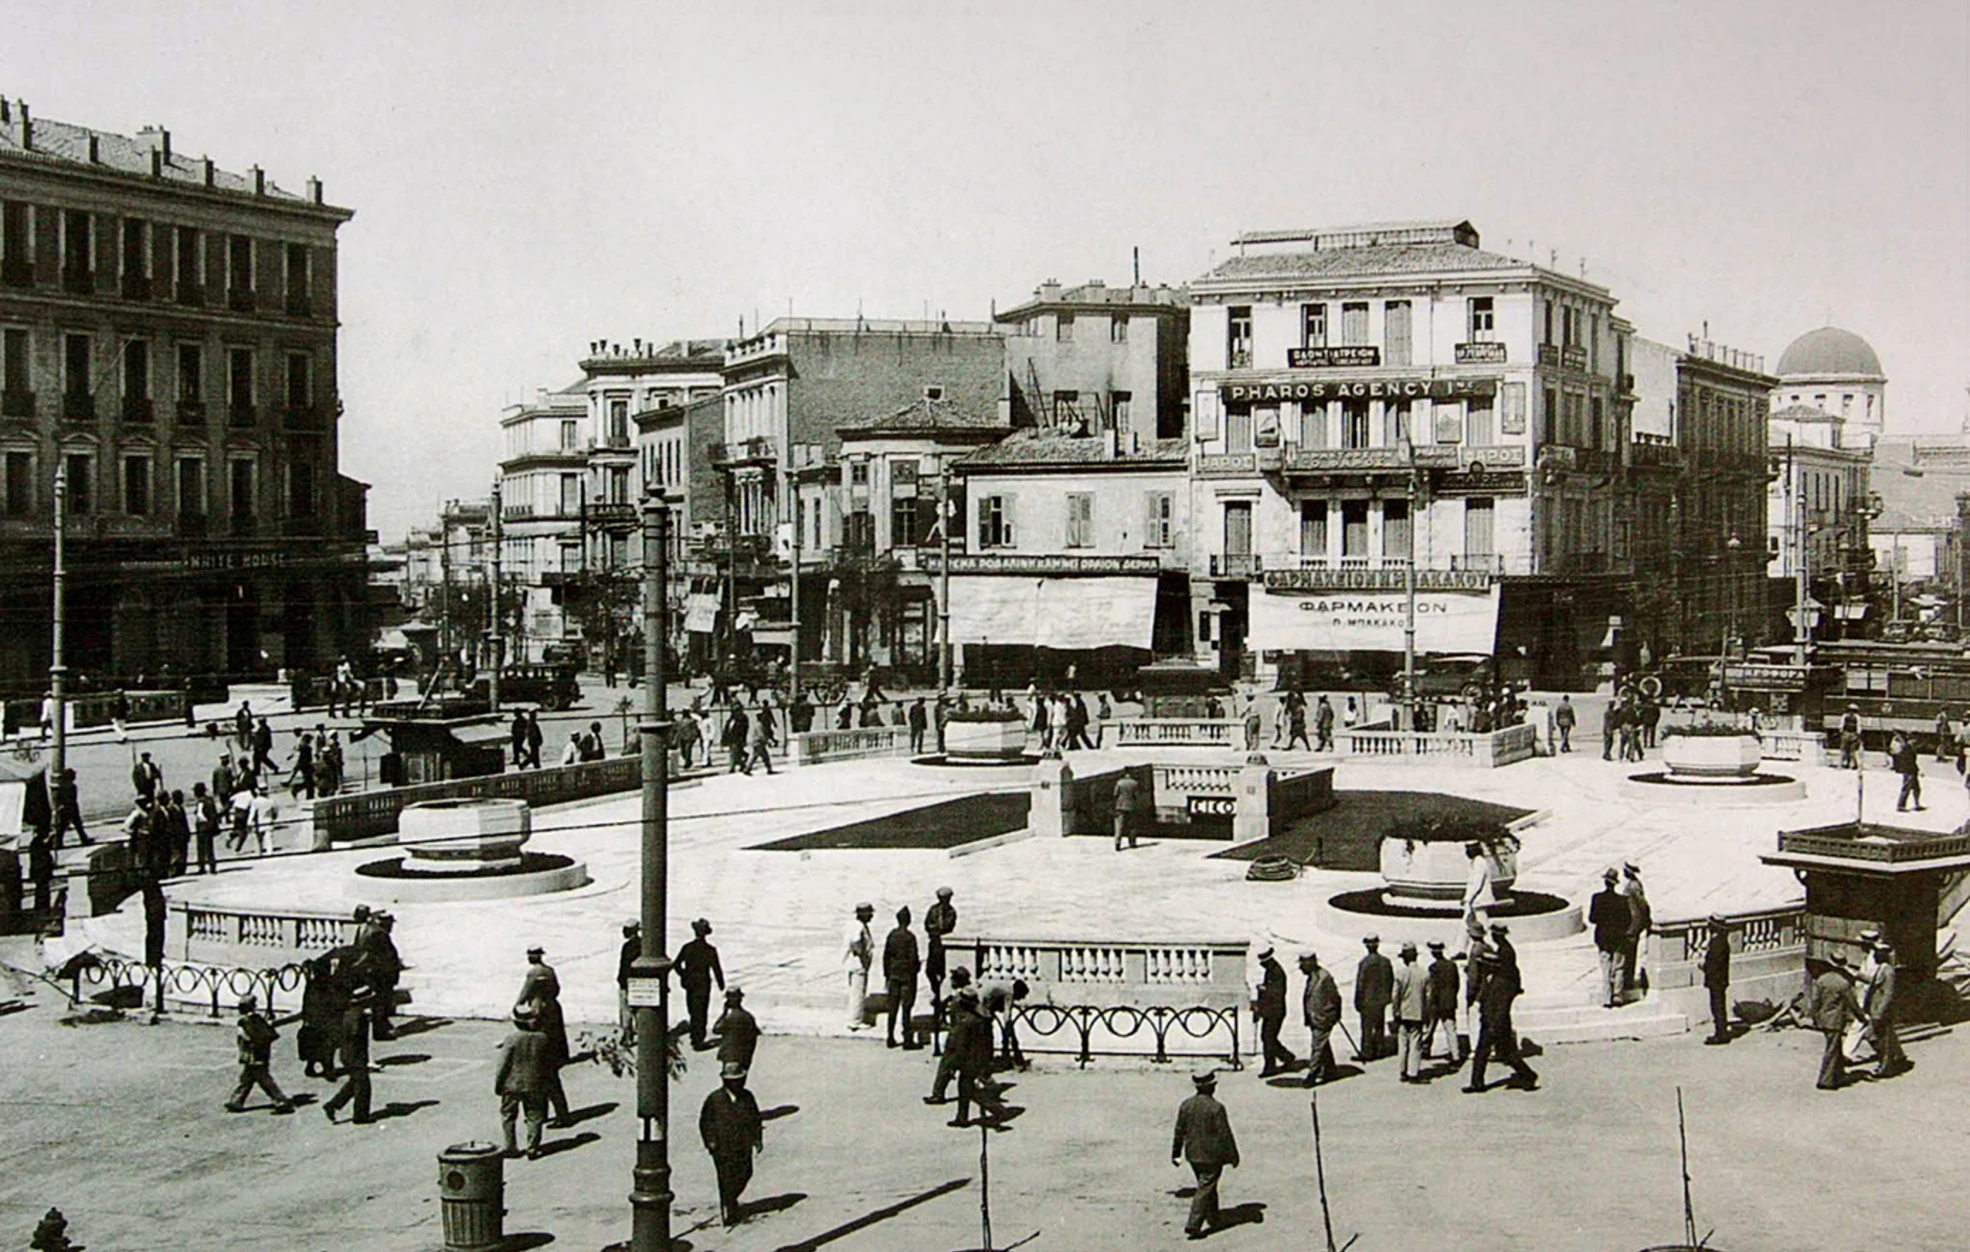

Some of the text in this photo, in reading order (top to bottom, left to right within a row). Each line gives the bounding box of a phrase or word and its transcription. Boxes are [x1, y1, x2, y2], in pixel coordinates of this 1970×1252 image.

[1232, 383, 1325, 399] PHAROS
[1337, 381, 1432, 397] AGENCY
[190, 552, 285, 569] WHITE HOUSE
[1298, 601, 1447, 614] ΦΑΡΜΑΚΕΟΝ
